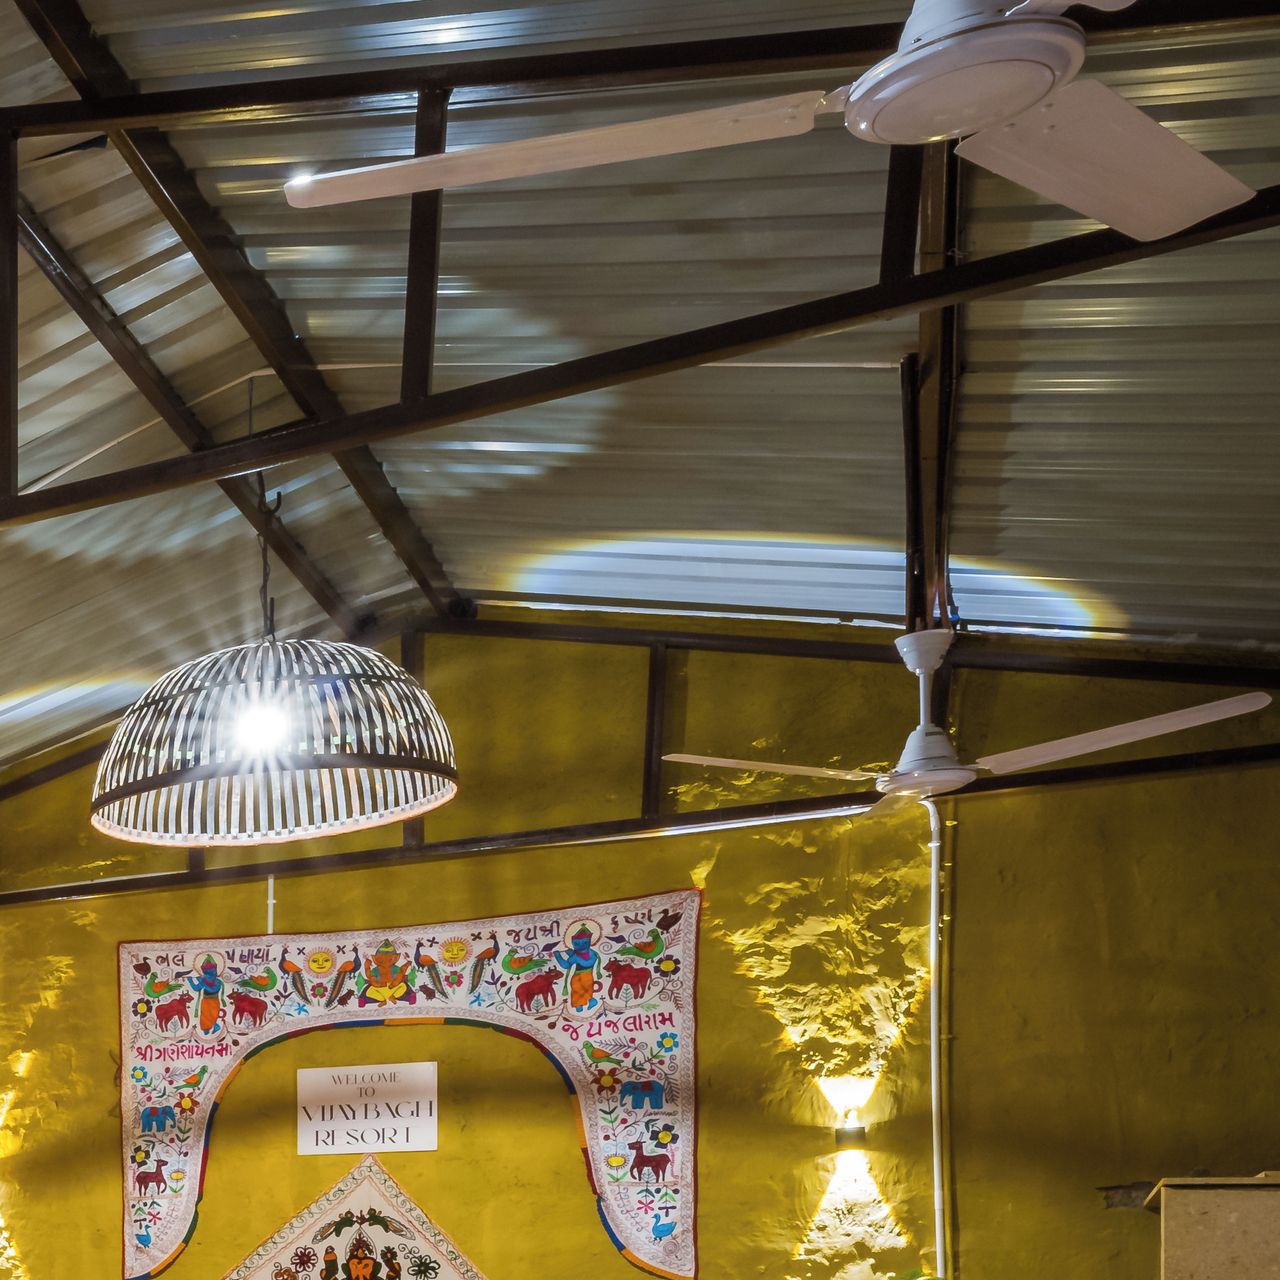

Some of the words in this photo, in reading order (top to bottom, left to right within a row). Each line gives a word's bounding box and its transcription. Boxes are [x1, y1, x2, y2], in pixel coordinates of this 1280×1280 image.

[331, 1071, 401, 1086] WELCOME
[356, 1086, 376, 1098] TO
[302, 1100, 434, 1122] VIJAYBAGH
[315, 1126, 413, 1147] RESORT
